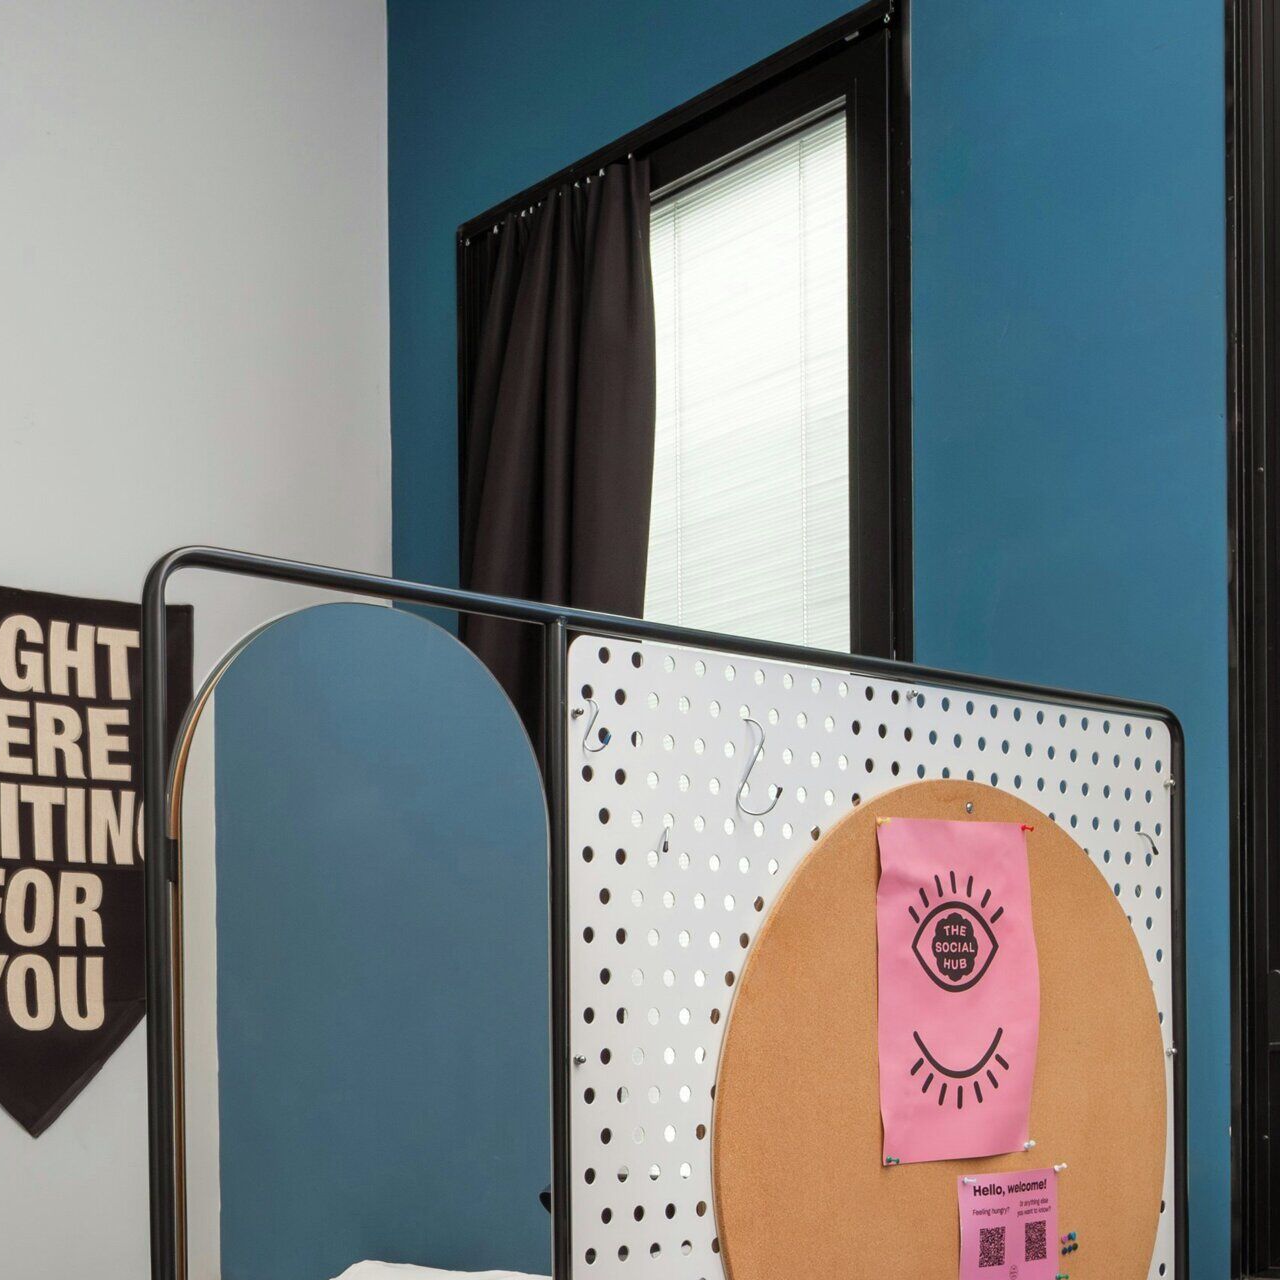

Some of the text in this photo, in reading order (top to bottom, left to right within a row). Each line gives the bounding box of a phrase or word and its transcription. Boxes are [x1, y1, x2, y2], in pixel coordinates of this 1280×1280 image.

[943, 925, 967, 936] THE
[935, 942, 975, 953] SOCIAL
[943, 958, 967, 970] HUB
[973, 1179, 1047, 1197] Hello, welcome!
